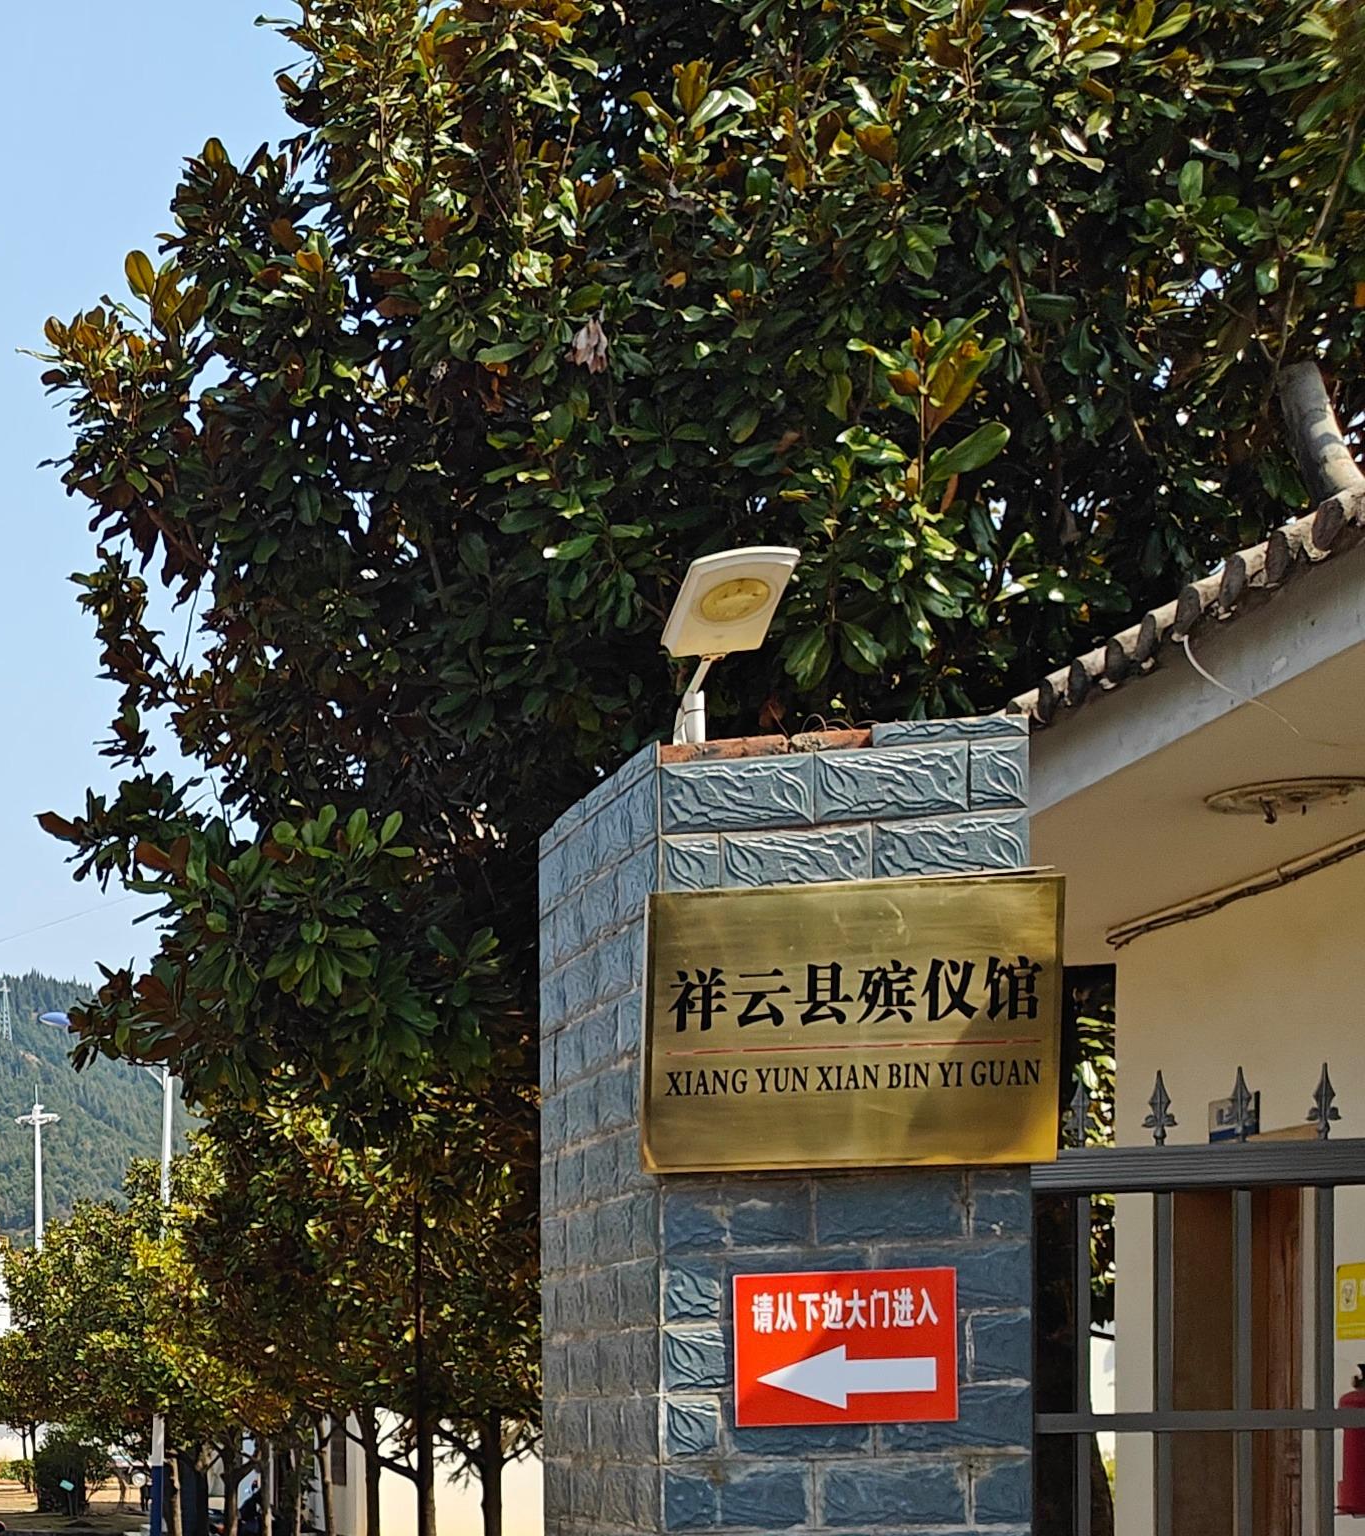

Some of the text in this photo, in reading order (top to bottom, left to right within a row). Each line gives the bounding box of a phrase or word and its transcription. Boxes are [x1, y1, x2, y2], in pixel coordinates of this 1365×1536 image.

[667, 954, 1044, 1033] 祥云县殡仪馆
[665, 1058, 1042, 1097] XIANG YUN XIAN BIN YI GUAN
[750, 1287, 939, 1334] 请从下边大门进入
